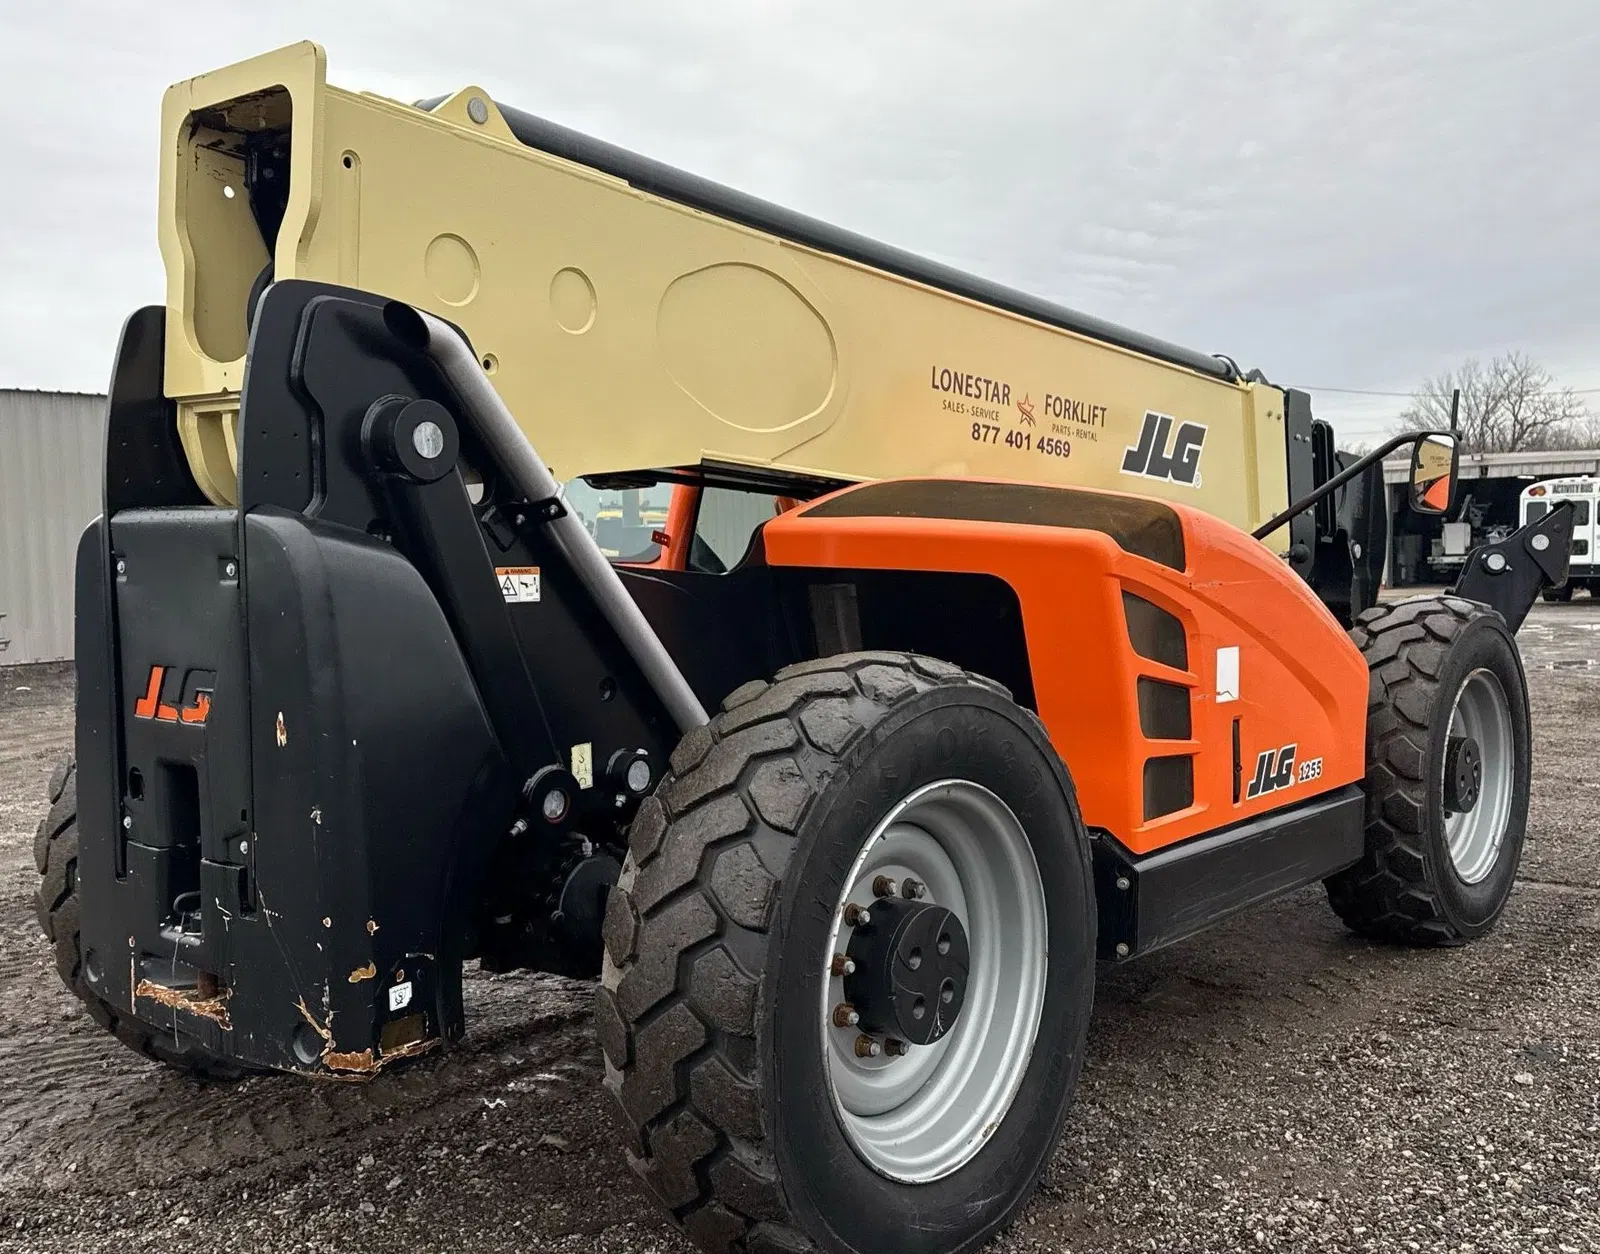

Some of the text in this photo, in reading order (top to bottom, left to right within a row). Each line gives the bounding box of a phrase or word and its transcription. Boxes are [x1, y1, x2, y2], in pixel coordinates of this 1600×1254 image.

[931, 365, 1108, 428] LONESTAR FORKLIFT
[942, 399, 1000, 422] SALES SERVICE
[971, 422, 1071, 459] 877 401 4569
[1051, 423, 1098, 442] PARTS RENTAL
[1120, 409, 1207, 487] JLG
[1552, 484, 1580, 494] ACTIVITY
[134, 664, 218, 727] JLG
[1246, 743, 1323, 800] JLG 1255
